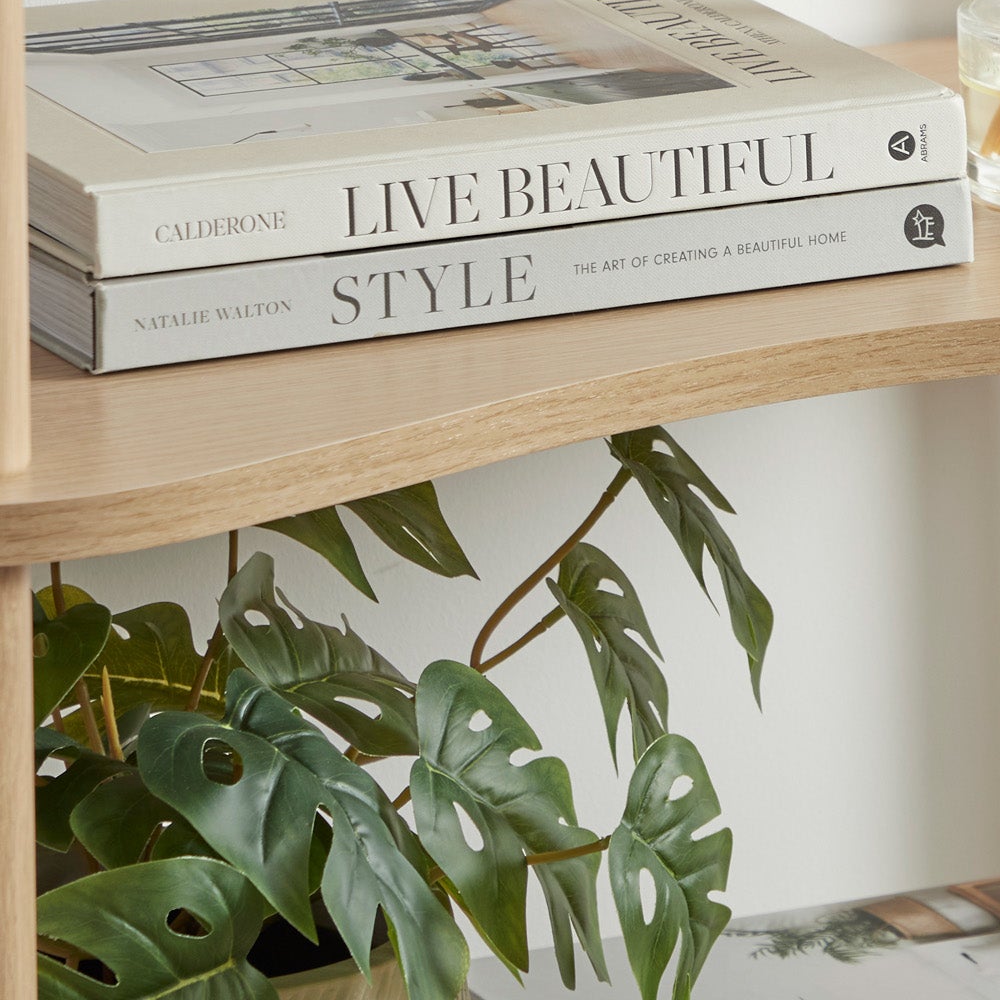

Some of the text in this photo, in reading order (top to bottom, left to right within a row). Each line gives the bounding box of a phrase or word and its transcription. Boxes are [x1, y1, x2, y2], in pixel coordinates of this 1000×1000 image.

[919, 123, 929, 163] ABRAMS
[342, 131, 835, 239] LIVE BEAUTIFUL
[154, 211, 287, 245] CALDERONE
[573, 230, 847, 275] THE ART OF CREATING A BEAUTIFUL HOME
[330, 254, 537, 326] STYLE
[133, 299, 293, 333] NATALIE WALTON
